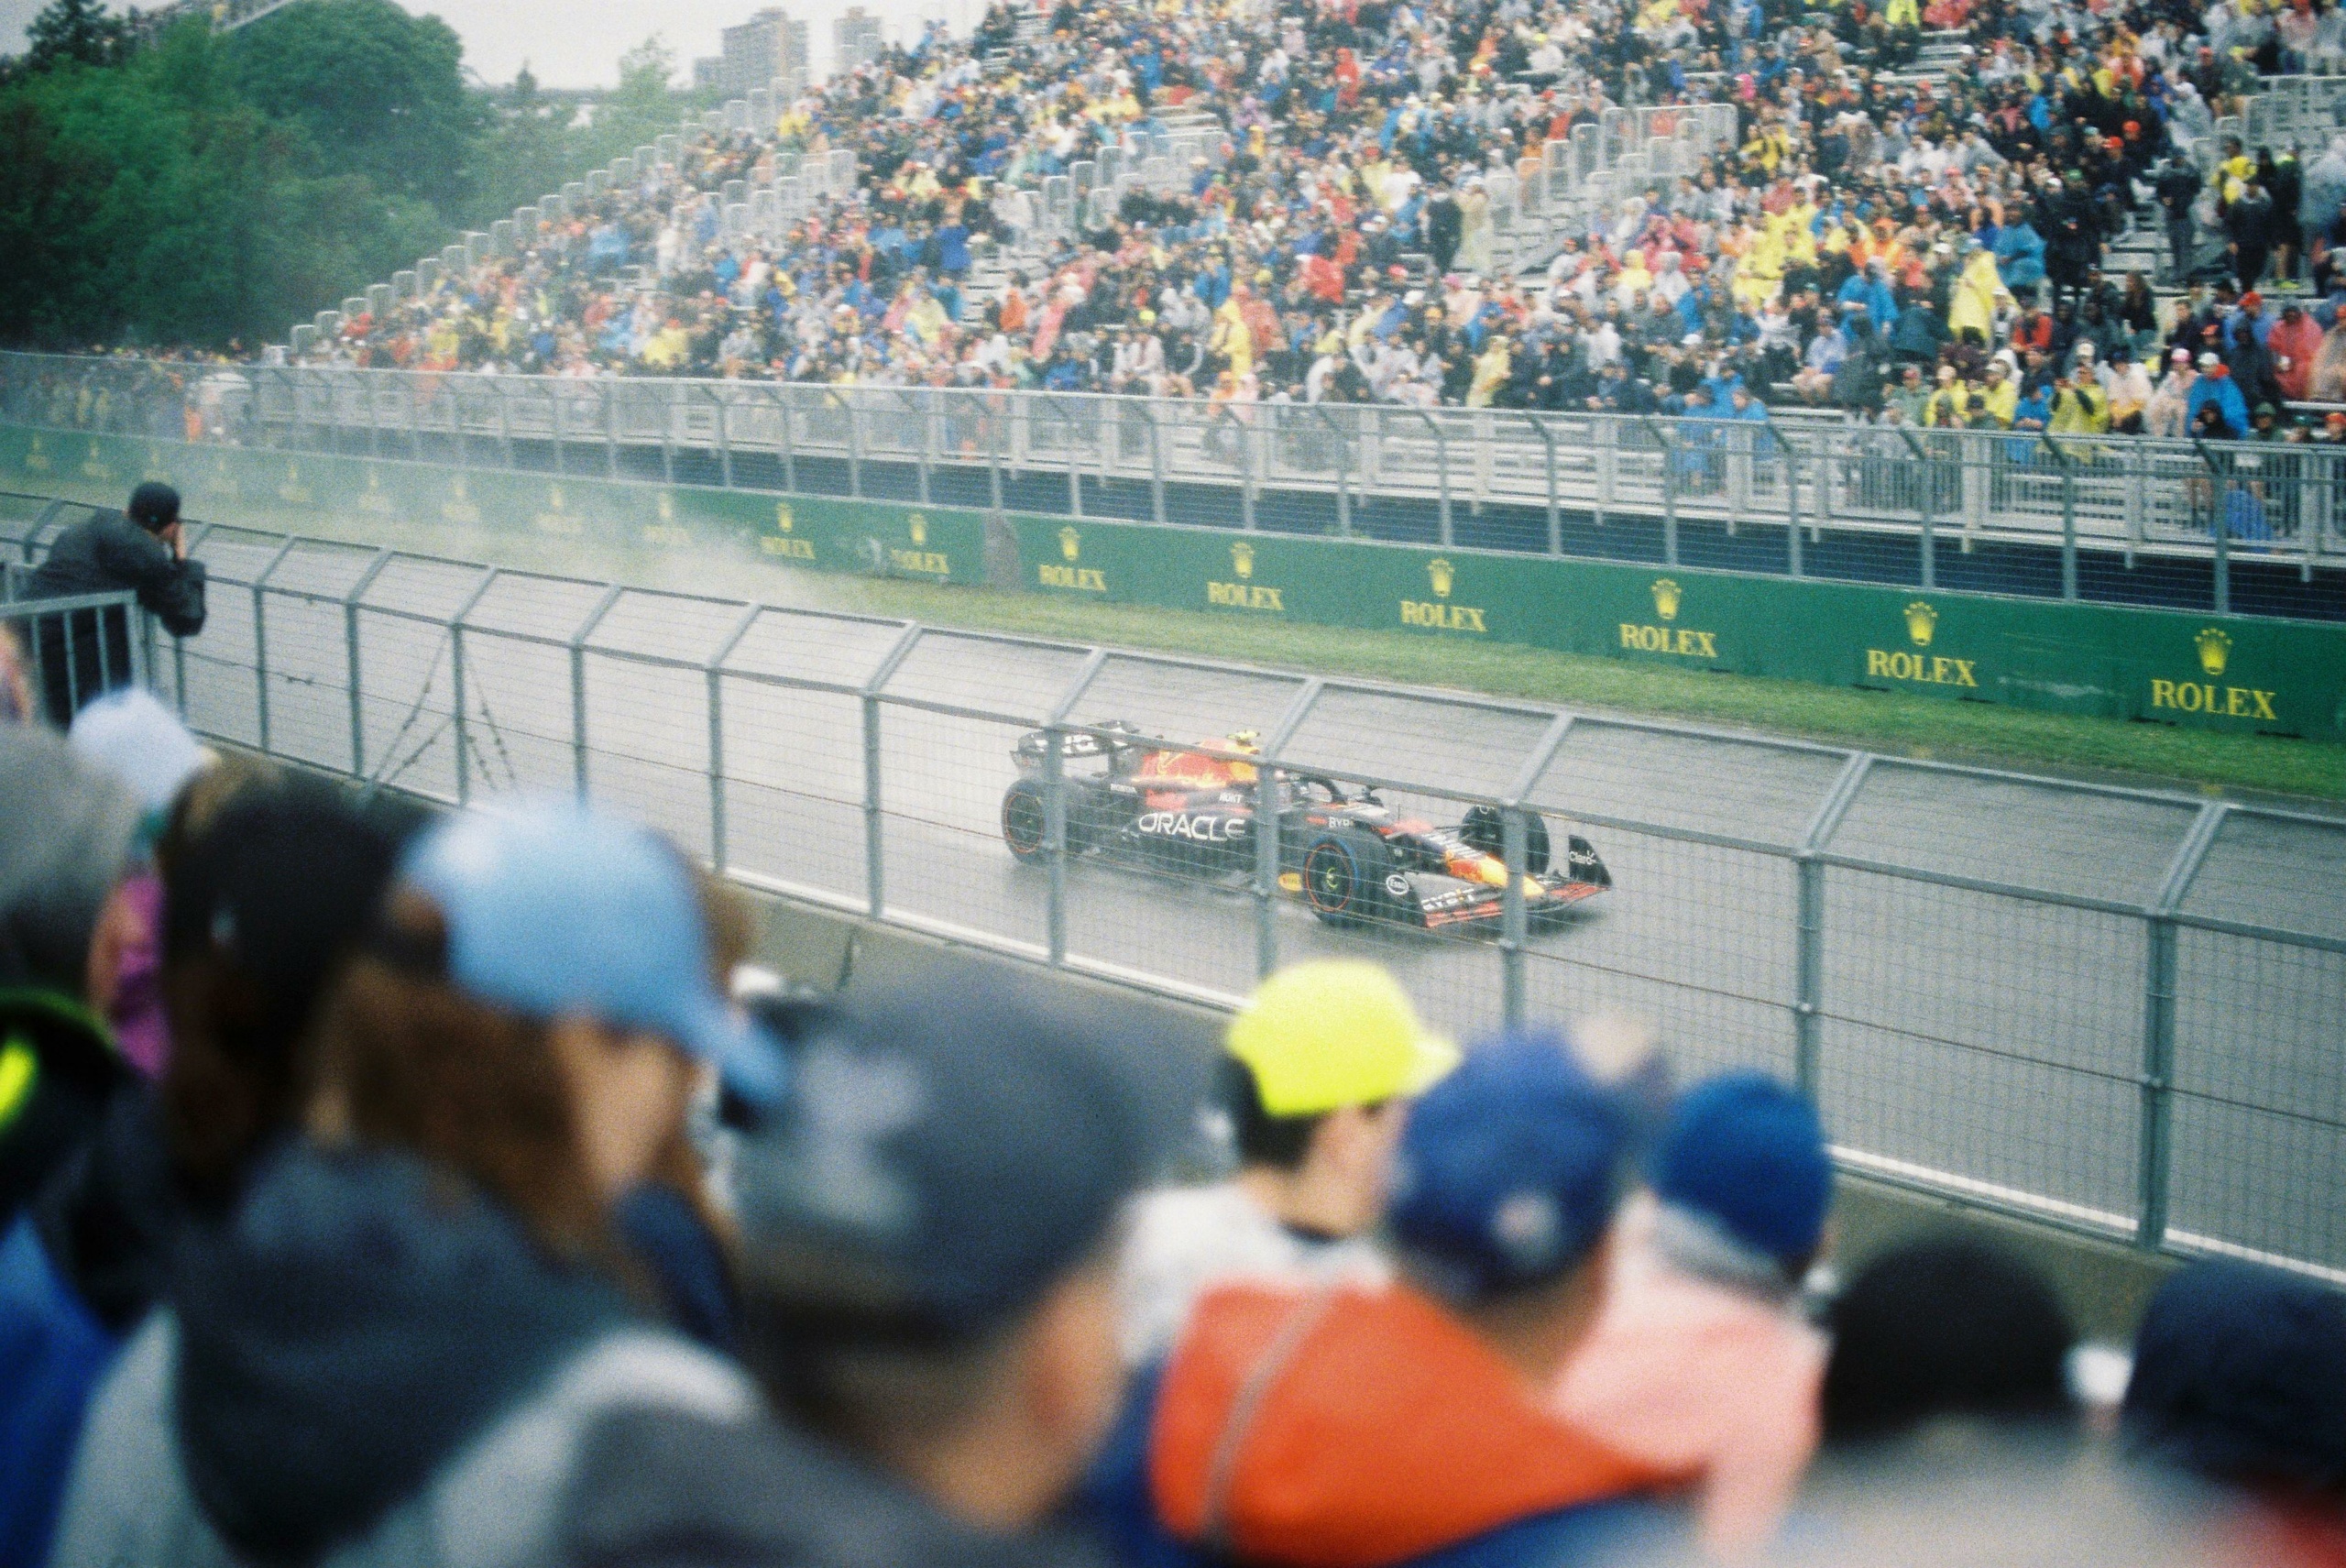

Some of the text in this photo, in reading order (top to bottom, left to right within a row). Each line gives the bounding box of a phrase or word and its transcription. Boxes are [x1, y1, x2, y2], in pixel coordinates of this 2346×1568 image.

[1039, 564, 1106, 591] ROLEX
[1207, 581, 1284, 611] ROLEX
[1400, 600, 1487, 633] ROLEX
[1619, 623, 1717, 658] ROLEX
[1868, 650, 1978, 688] ROLEX
[2152, 679, 2276, 720] ROLEX
[1138, 812, 1245, 841] ORACLE
